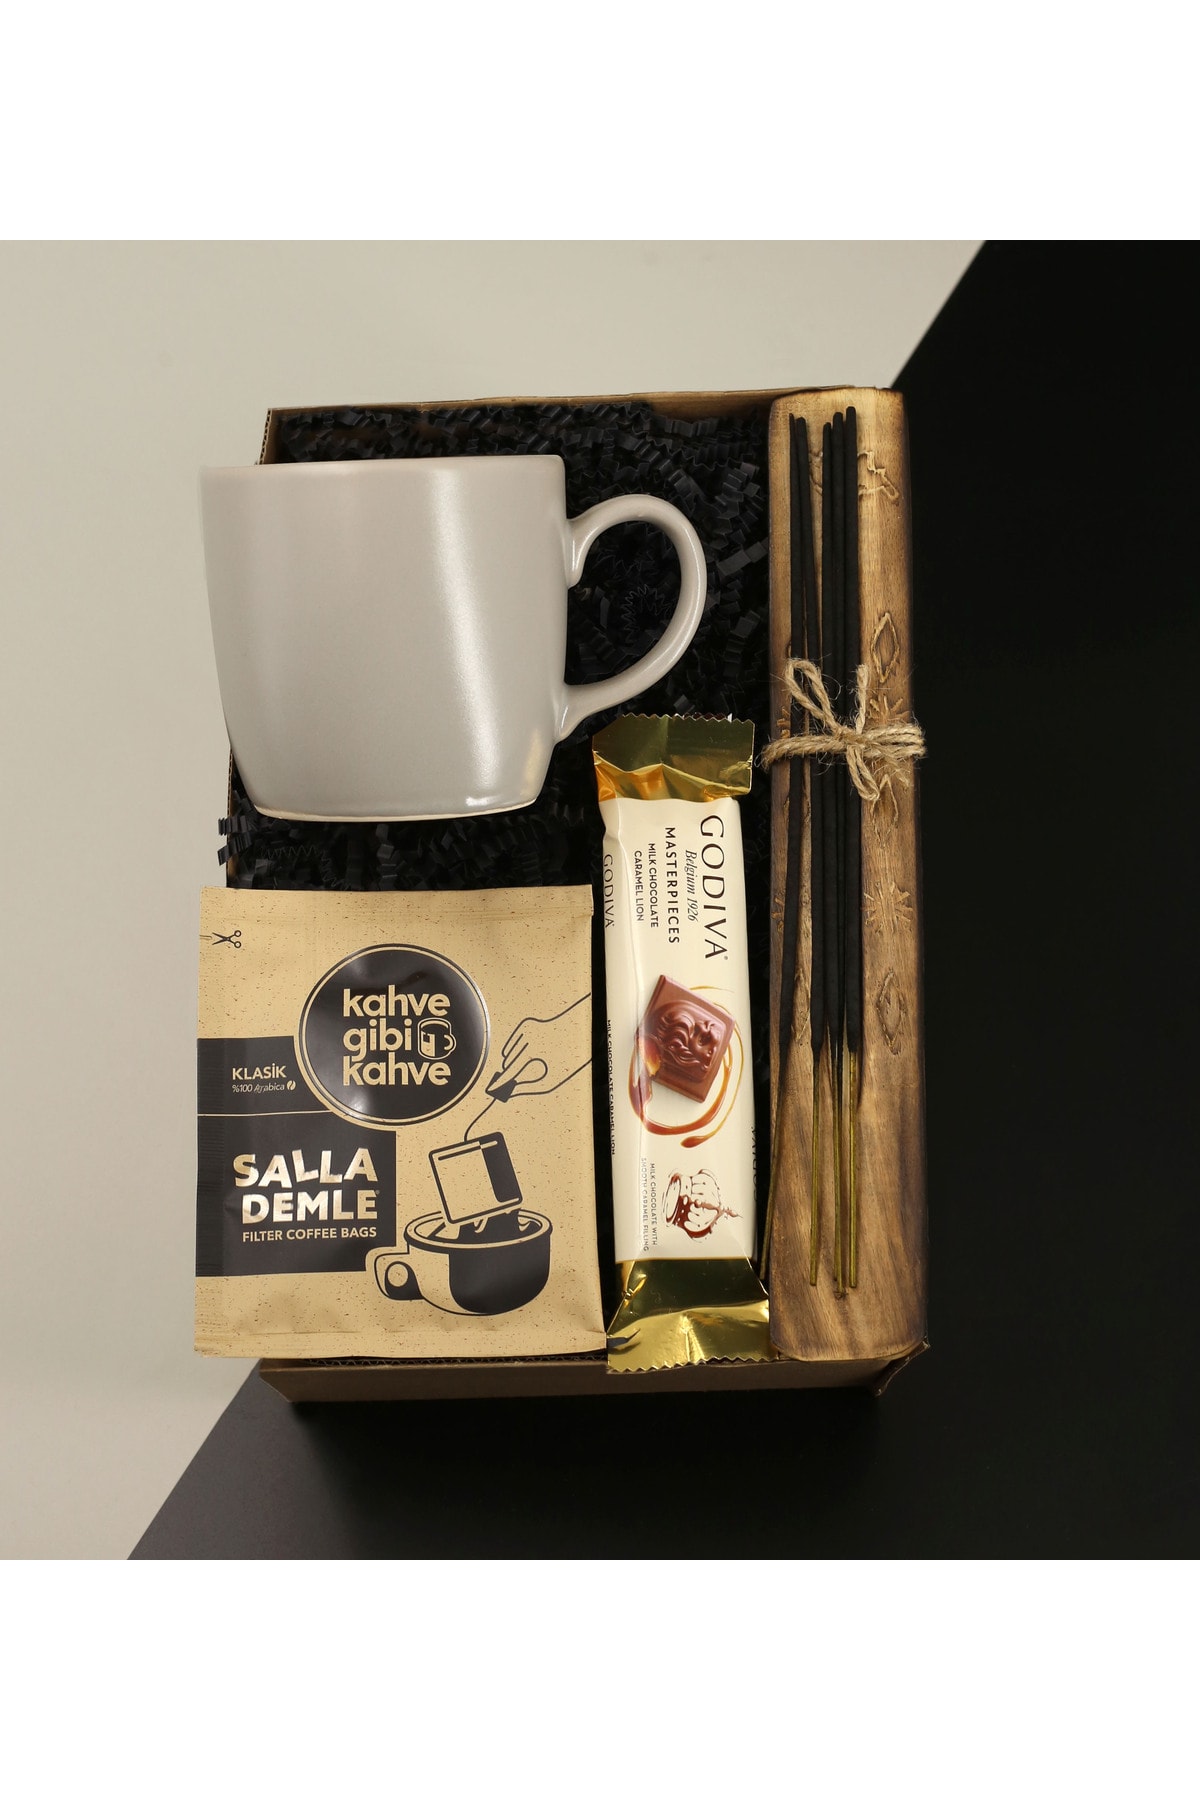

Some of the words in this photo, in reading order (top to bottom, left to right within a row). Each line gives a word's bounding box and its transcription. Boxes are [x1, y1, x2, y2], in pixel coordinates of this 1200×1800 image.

[648, 843, 657, 866] MILK
[684, 849, 698, 895] Belgium
[603, 854, 614, 928] GODIVA
[634, 850, 644, 896] CARAMEL
[665, 827, 680, 944] MASTERPIECES
[700, 814, 728, 959] GODIVA
[636, 898, 645, 922] LION
[648, 867, 659, 928] CHOCOLATE
[687, 897, 698, 922] 1926
[342, 984, 451, 1017] kahve
[342, 1018, 412, 1062] gibi
[232, 1062, 287, 1080] KLASİK
[342, 1051, 451, 1087] kahve
[232, 1084, 253, 1093] %100
[253, 1082, 285, 1093] Arabica
[232, 1147, 378, 1189] SALLA
[242, 1189, 378, 1224] DEMLE
[242, 1230, 283, 1243] FILTER
[286, 1228, 337, 1240] COFFEE
[341, 1227, 377, 1239] BAGS
